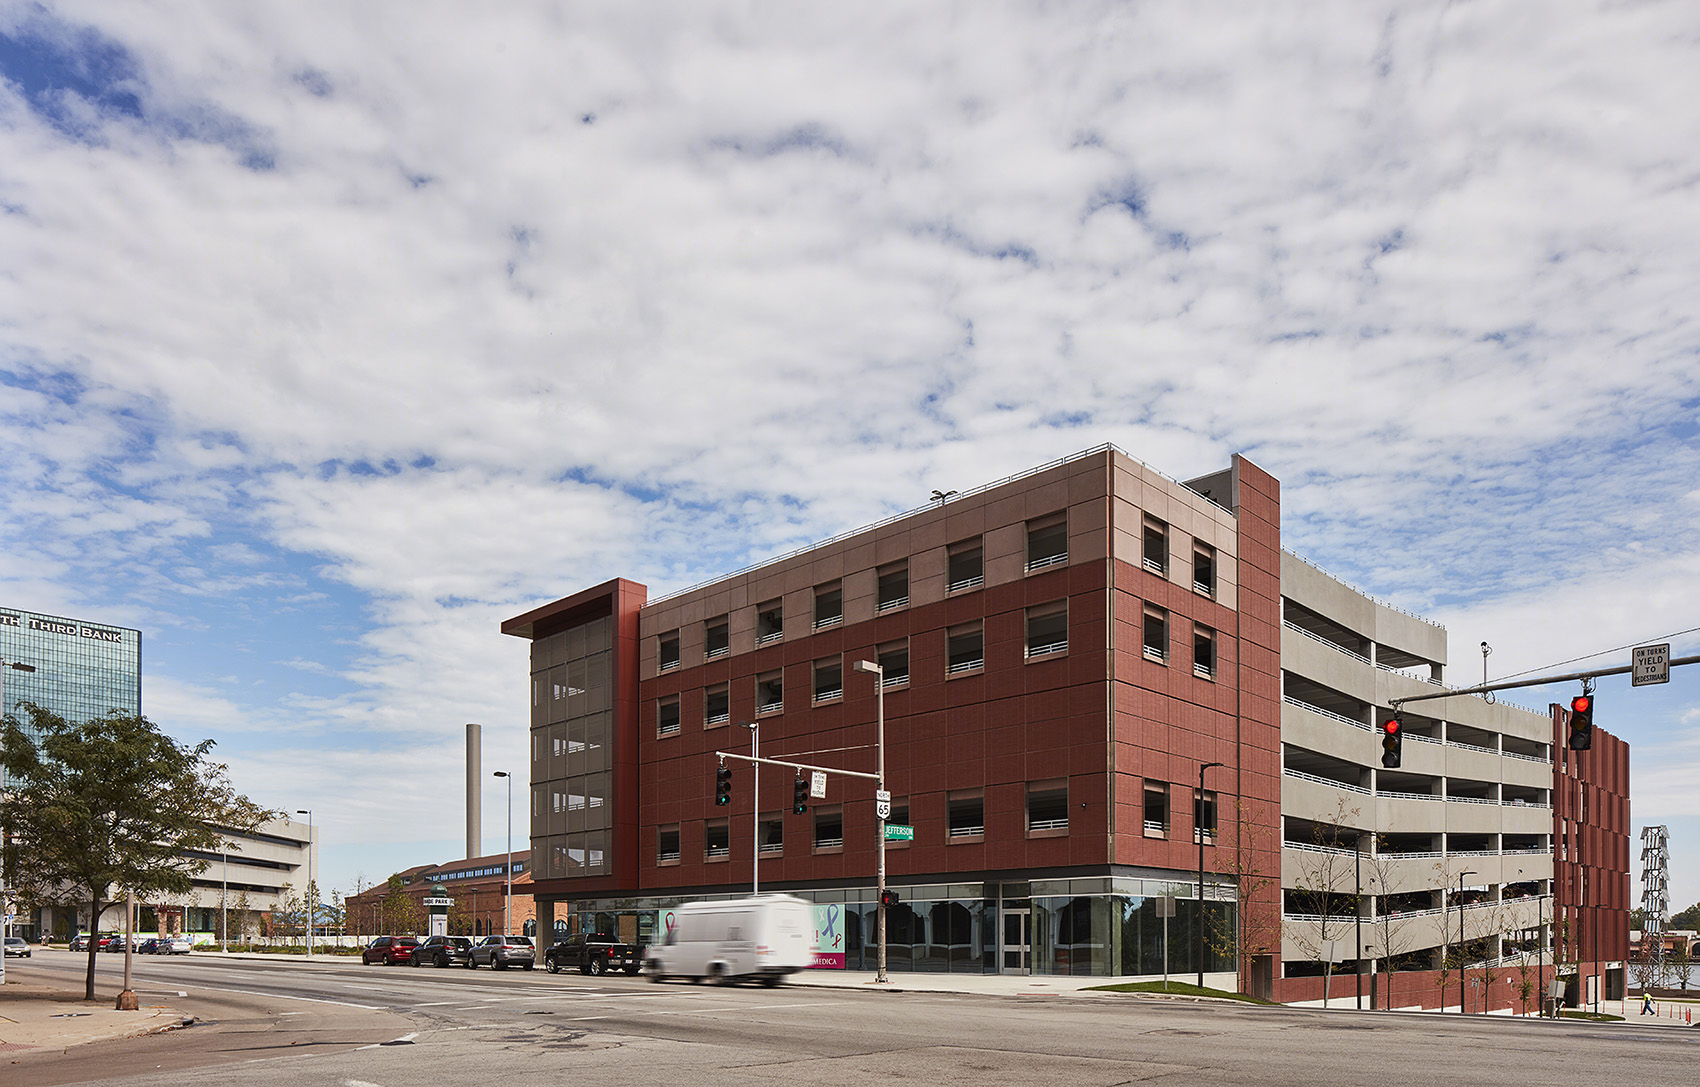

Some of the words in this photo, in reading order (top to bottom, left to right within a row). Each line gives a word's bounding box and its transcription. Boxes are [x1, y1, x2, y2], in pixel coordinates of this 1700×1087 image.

[29, 619, 76, 635] THIRD
[81, 627, 121, 643] BANK
[1647, 647, 1666, 656] TURNS
[1638, 655, 1663, 666] YIELD
[1645, 665, 1656, 673] TO
[1634, 673, 1667, 683] PEDESTRIANS
[878, 804, 889, 815] 65
[885, 825, 913, 836] JEFFERSON
